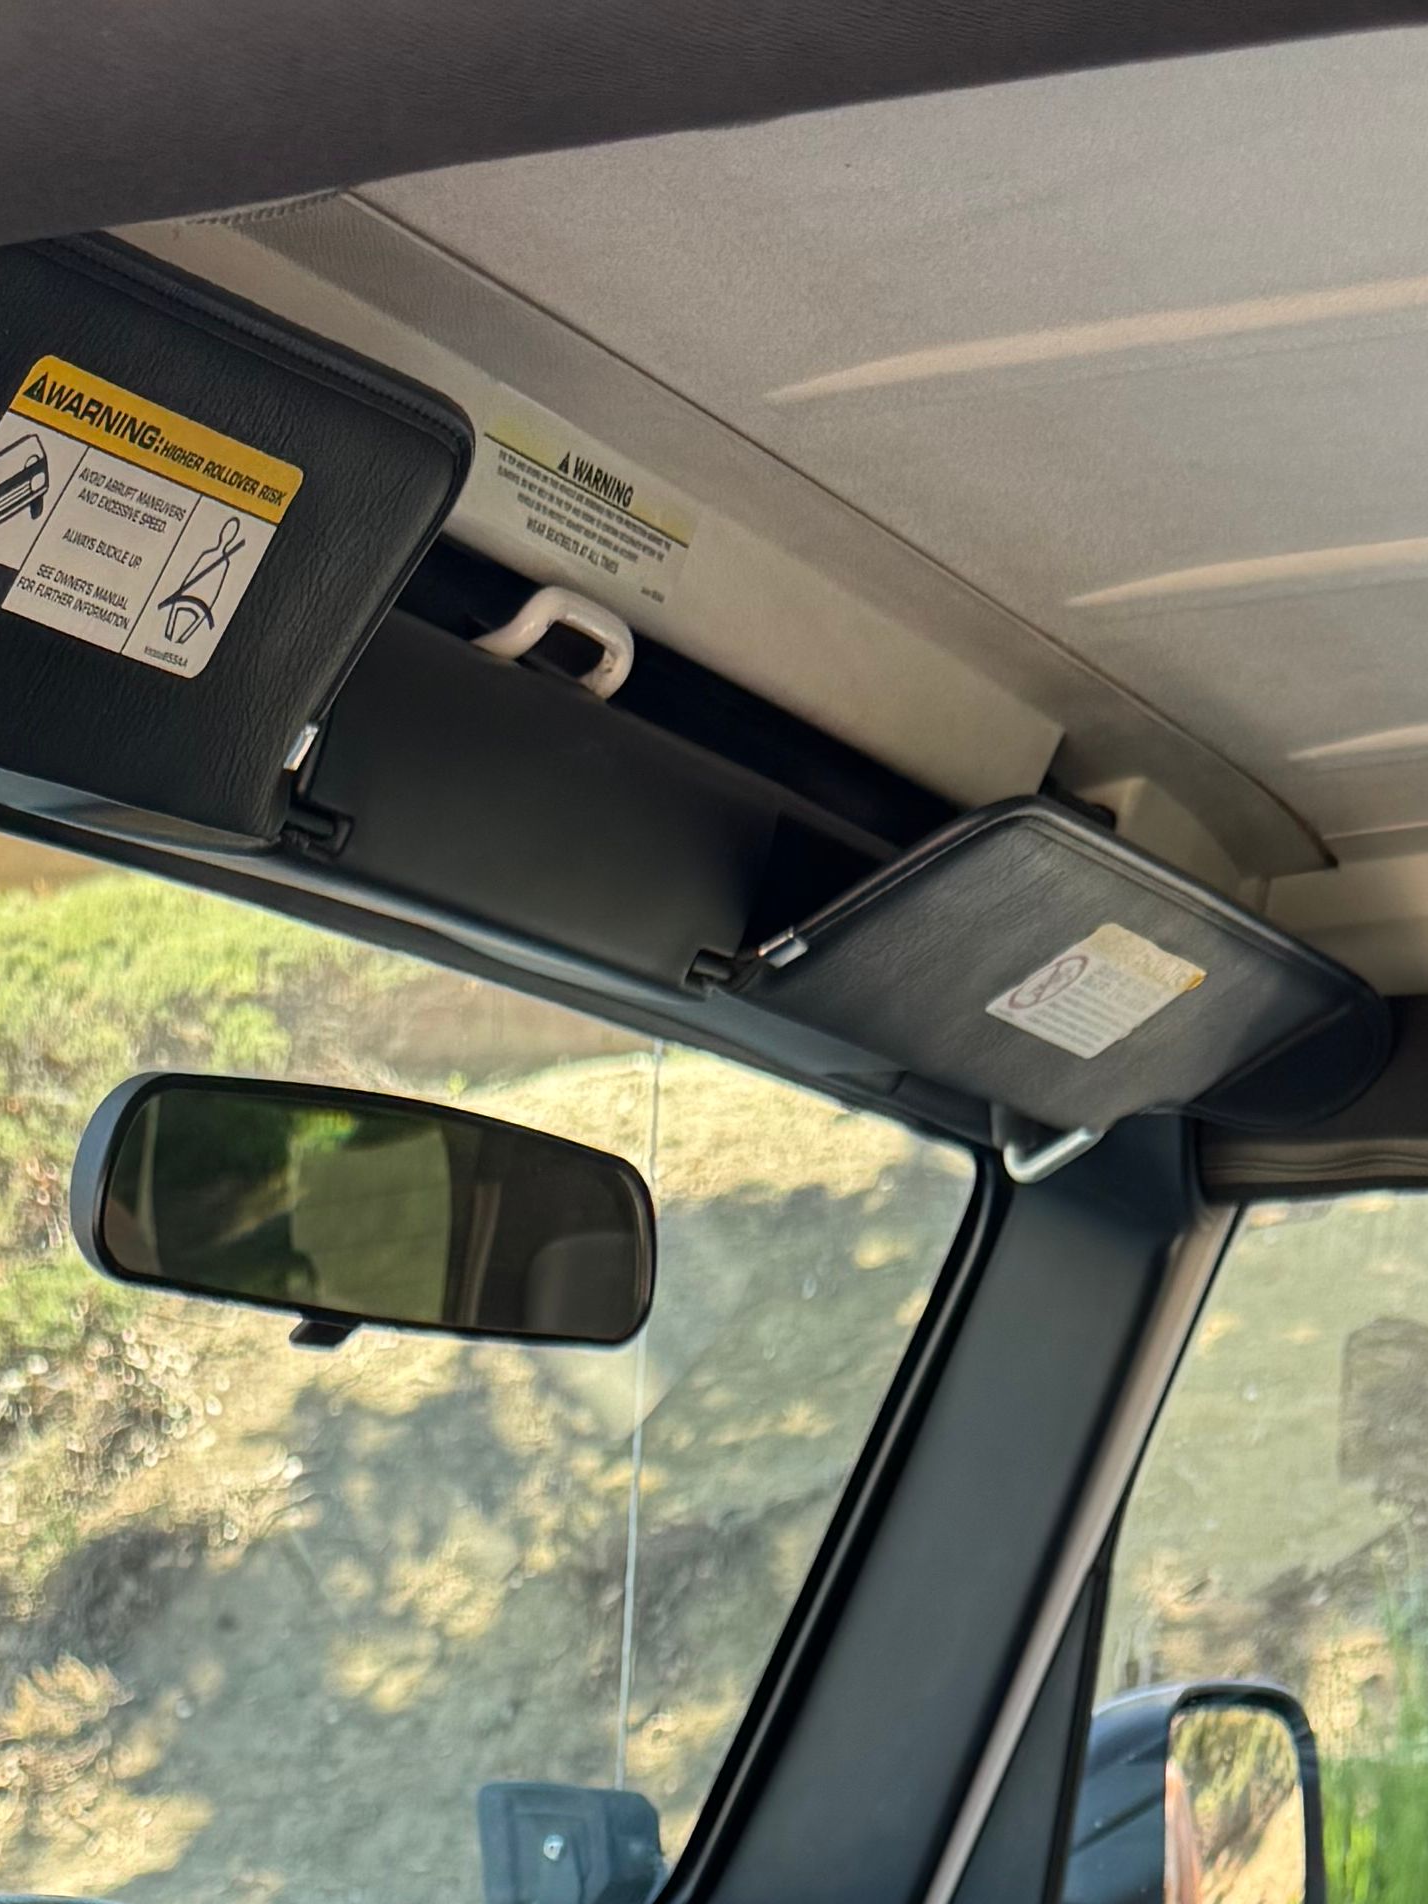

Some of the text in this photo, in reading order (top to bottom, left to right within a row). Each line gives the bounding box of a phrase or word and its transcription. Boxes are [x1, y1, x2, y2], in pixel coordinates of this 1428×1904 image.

[78, 467, 188, 522] AVOID ABRUPT MANEUVERS
[160, 440, 208, 472] HIGHER
[203, 460, 261, 495] ROLLOVER
[258, 483, 289, 508] RISK
[572, 455, 635, 508] WARNING
[77, 488, 98, 506] AND
[95, 495, 140, 523] EXCESSIVE
[61, 528, 98, 552] ALWAYS
[95, 541, 131, 566] BUCKLE
[16, 575, 37, 593] FOR
[34, 582, 75, 607] FURTHER
[36, 563, 56, 580] SEE
[92, 585, 130, 611] MANUAL
